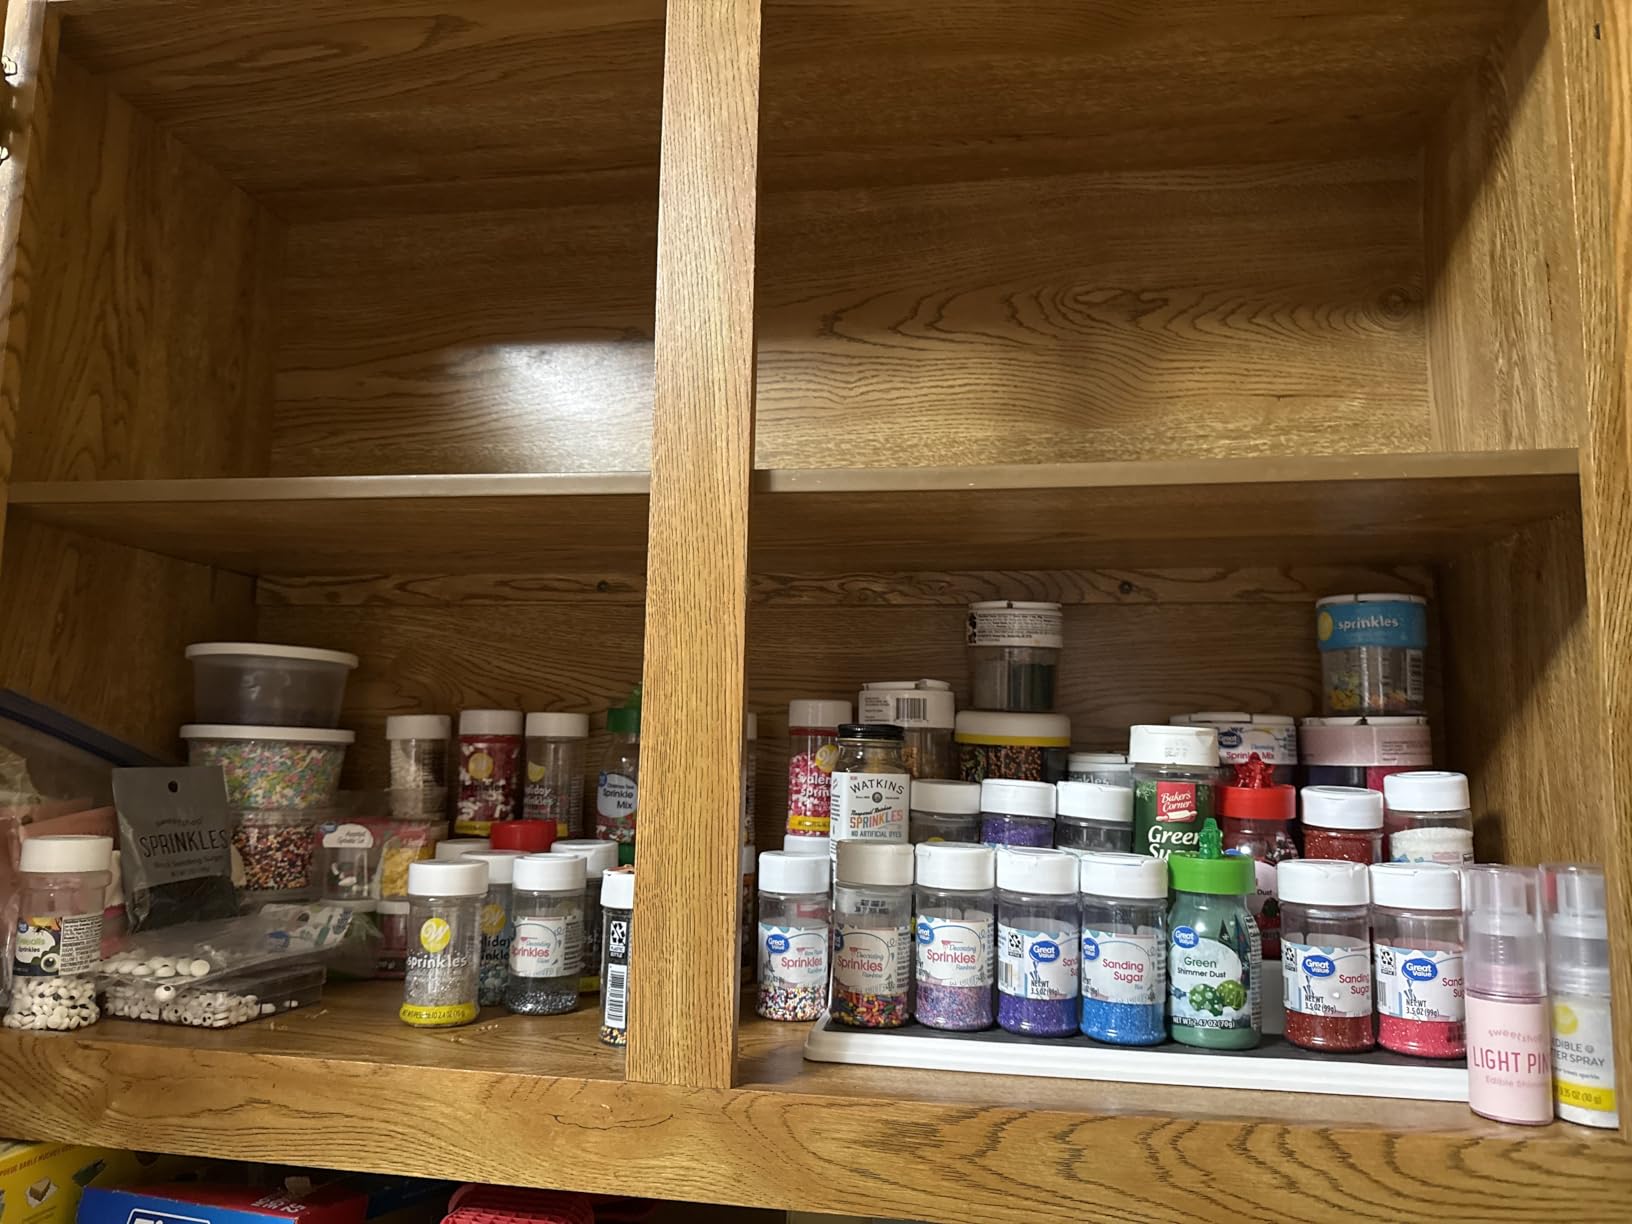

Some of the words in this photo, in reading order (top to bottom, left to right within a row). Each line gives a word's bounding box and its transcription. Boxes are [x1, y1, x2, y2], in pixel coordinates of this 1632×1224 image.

[1338, 616, 1399, 631] sprinkles
[850, 779, 905, 795] WATKINS
[1160, 790, 1192, 804] Baker's
[617, 800, 633, 809] Mix
[1162, 800, 1192, 812] Corner
[850, 809, 904, 829] SPRINKLES
[860, 830, 887, 838] ARTIFICIAL
[139, 829, 229, 857] SPRINKLES
[1175, 931, 1194, 941] Great
[768, 938, 785, 947] Great
[1033, 945, 1055, 954] Great
[407, 955, 468, 969] sprinkles
[927, 949, 976, 964] Sprinkles
[1184, 957, 1217, 968] Green
[781, 956, 823, 970] Sprinkles
[838, 957, 882, 972] Sprinkles
[1103, 958, 1144, 973] Sanding
[1305, 959, 1329, 969] Great
[1406, 963, 1432, 973] Great
[1114, 971, 1144, 983] Sugar
[1177, 967, 1208, 977] Shimmer
[1209, 970, 1226, 978] Dust
[1412, 970, 1433, 978] Value
[1305, 1002, 1314, 1010] 3.5
[1314, 1003, 1321, 1011] OZ
[1321, 1004, 1336, 1014] (99g)
[1417, 1000, 1426, 1008] WT
[1406, 1006, 1415, 1014] 3.5
[1415, 1007, 1424, 1015] OZ
[1424, 1007, 1439, 1017] (99g)
[1208, 1019, 1217, 1027] OZ
[1217, 1019, 1235, 1029] (70g)
[1473, 1045, 1521, 1073] LIGHT
[1569, 1053, 1605, 1067] SPRAY
